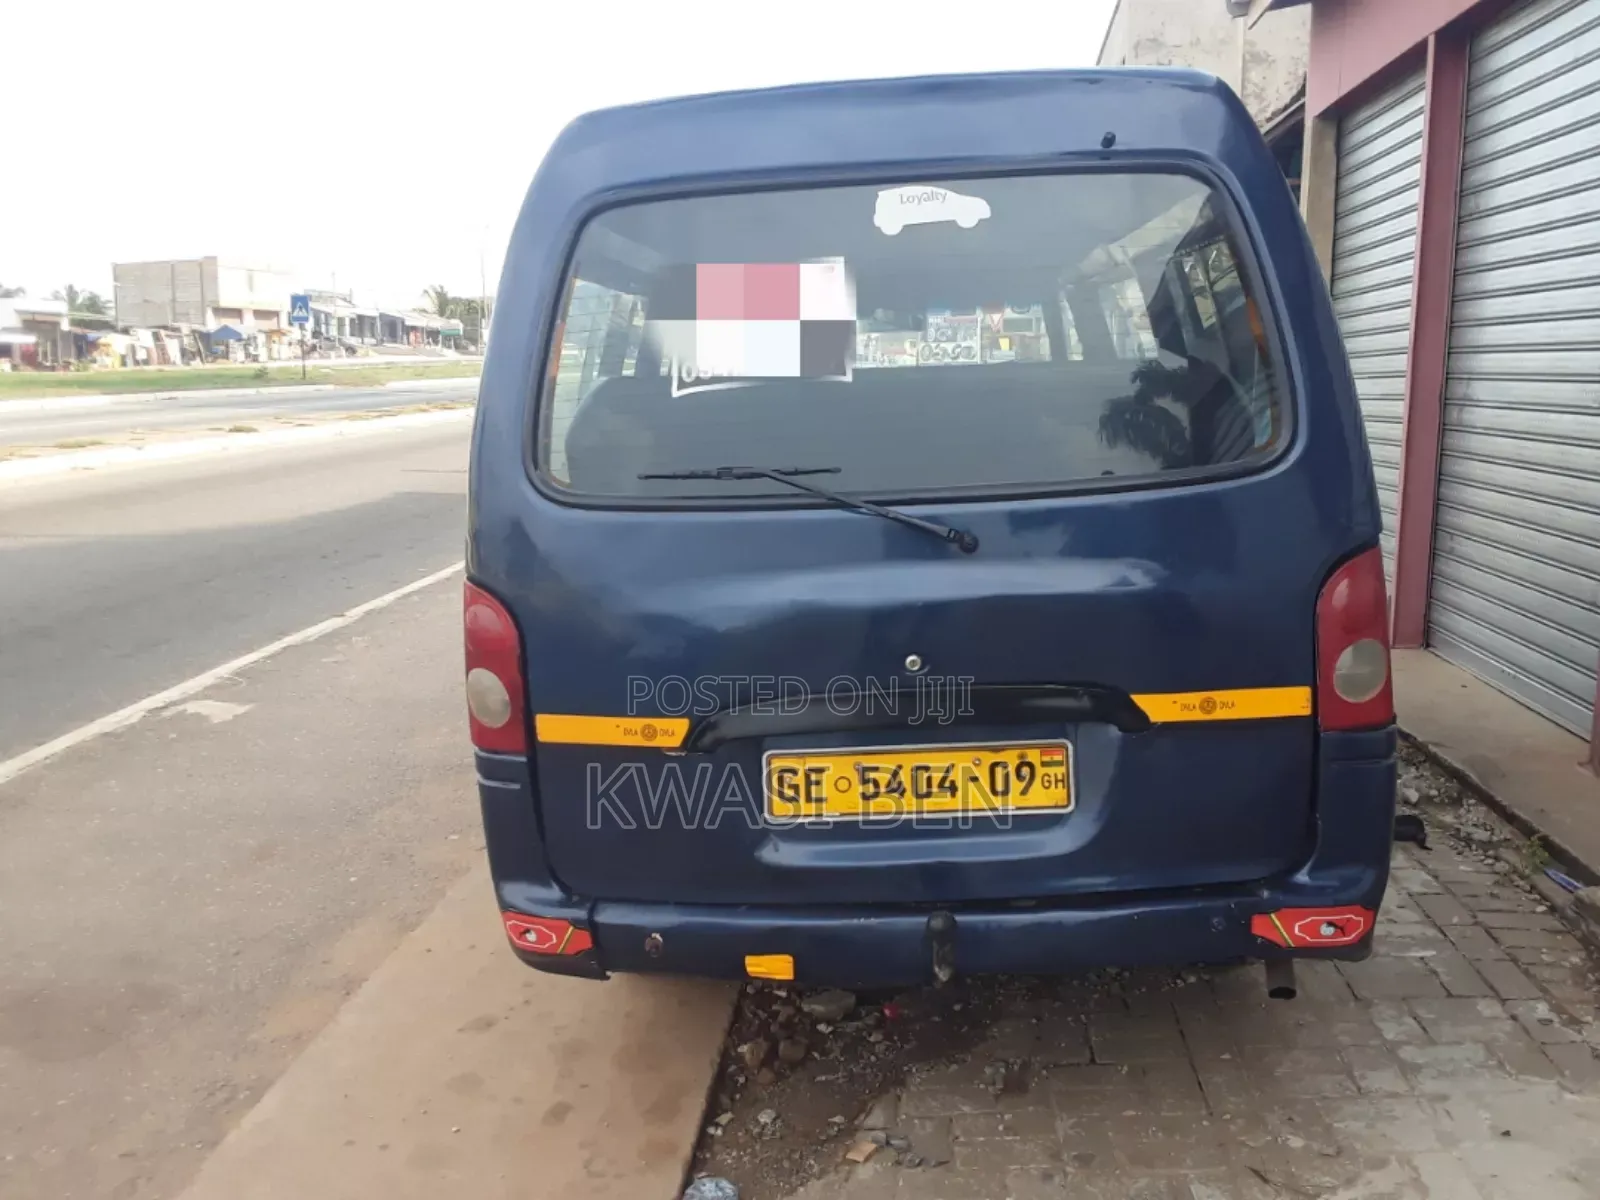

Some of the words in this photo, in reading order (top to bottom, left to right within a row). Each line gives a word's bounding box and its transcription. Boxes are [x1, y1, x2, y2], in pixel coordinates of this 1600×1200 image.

[899, 189, 947, 206] Loyalty
[776, 767, 827, 804] GE
[1041, 771, 1066, 790] GH
